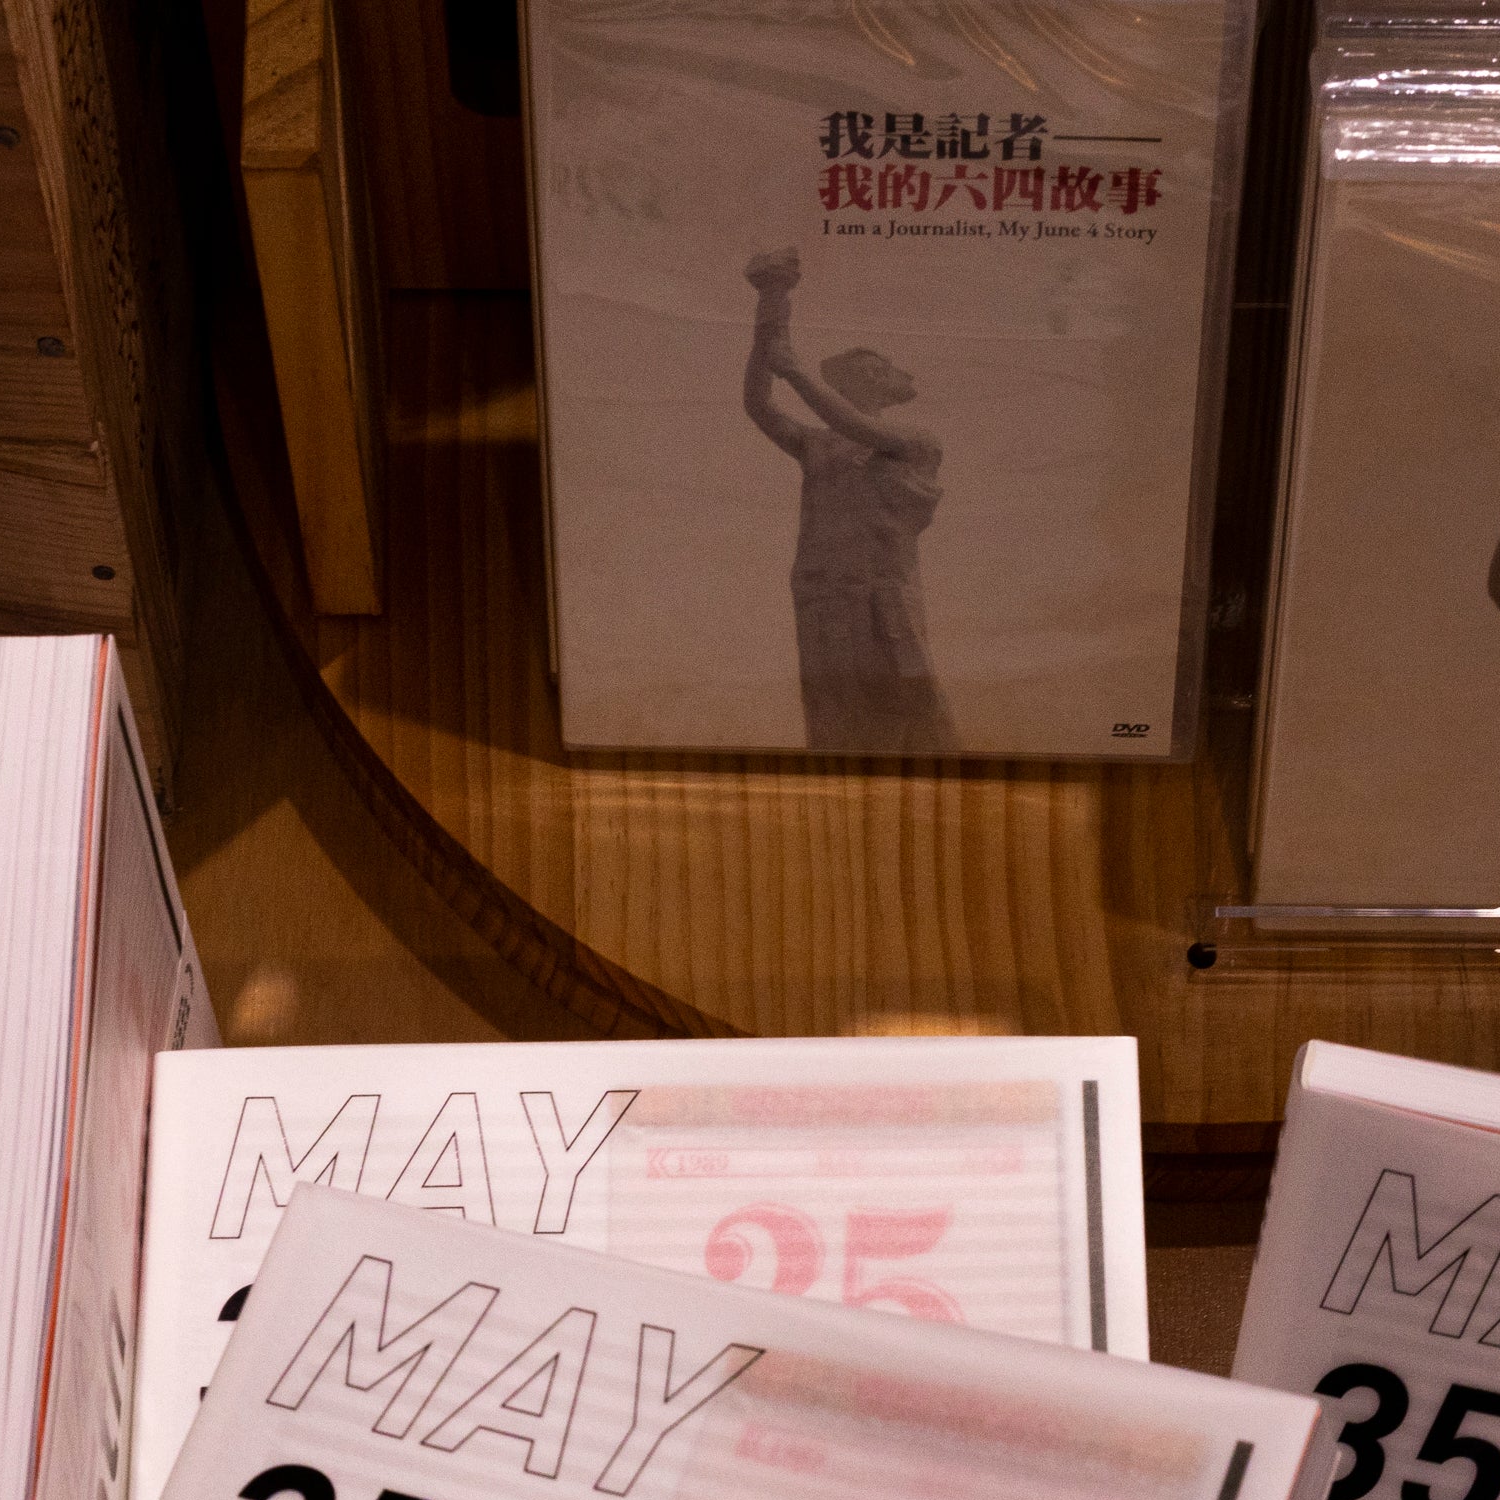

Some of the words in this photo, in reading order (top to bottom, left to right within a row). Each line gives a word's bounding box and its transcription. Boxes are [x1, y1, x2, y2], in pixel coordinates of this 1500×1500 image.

[817, 163, 1164, 215] 我的六四故事
[822, 219, 831, 236] I
[836, 222, 866, 237] am
[871, 223, 882, 237] a
[885, 219, 993, 240] Journalist,
[997, 220, 1031, 243] My
[1035, 220, 1081, 240] June
[1086, 221, 1099, 239] 4
[1103, 223, 1158, 245] Story
[1111, 723, 1151, 738] DVD
[209, 1089, 642, 1240] MAY
[265, 1254, 767, 1497] MAY
